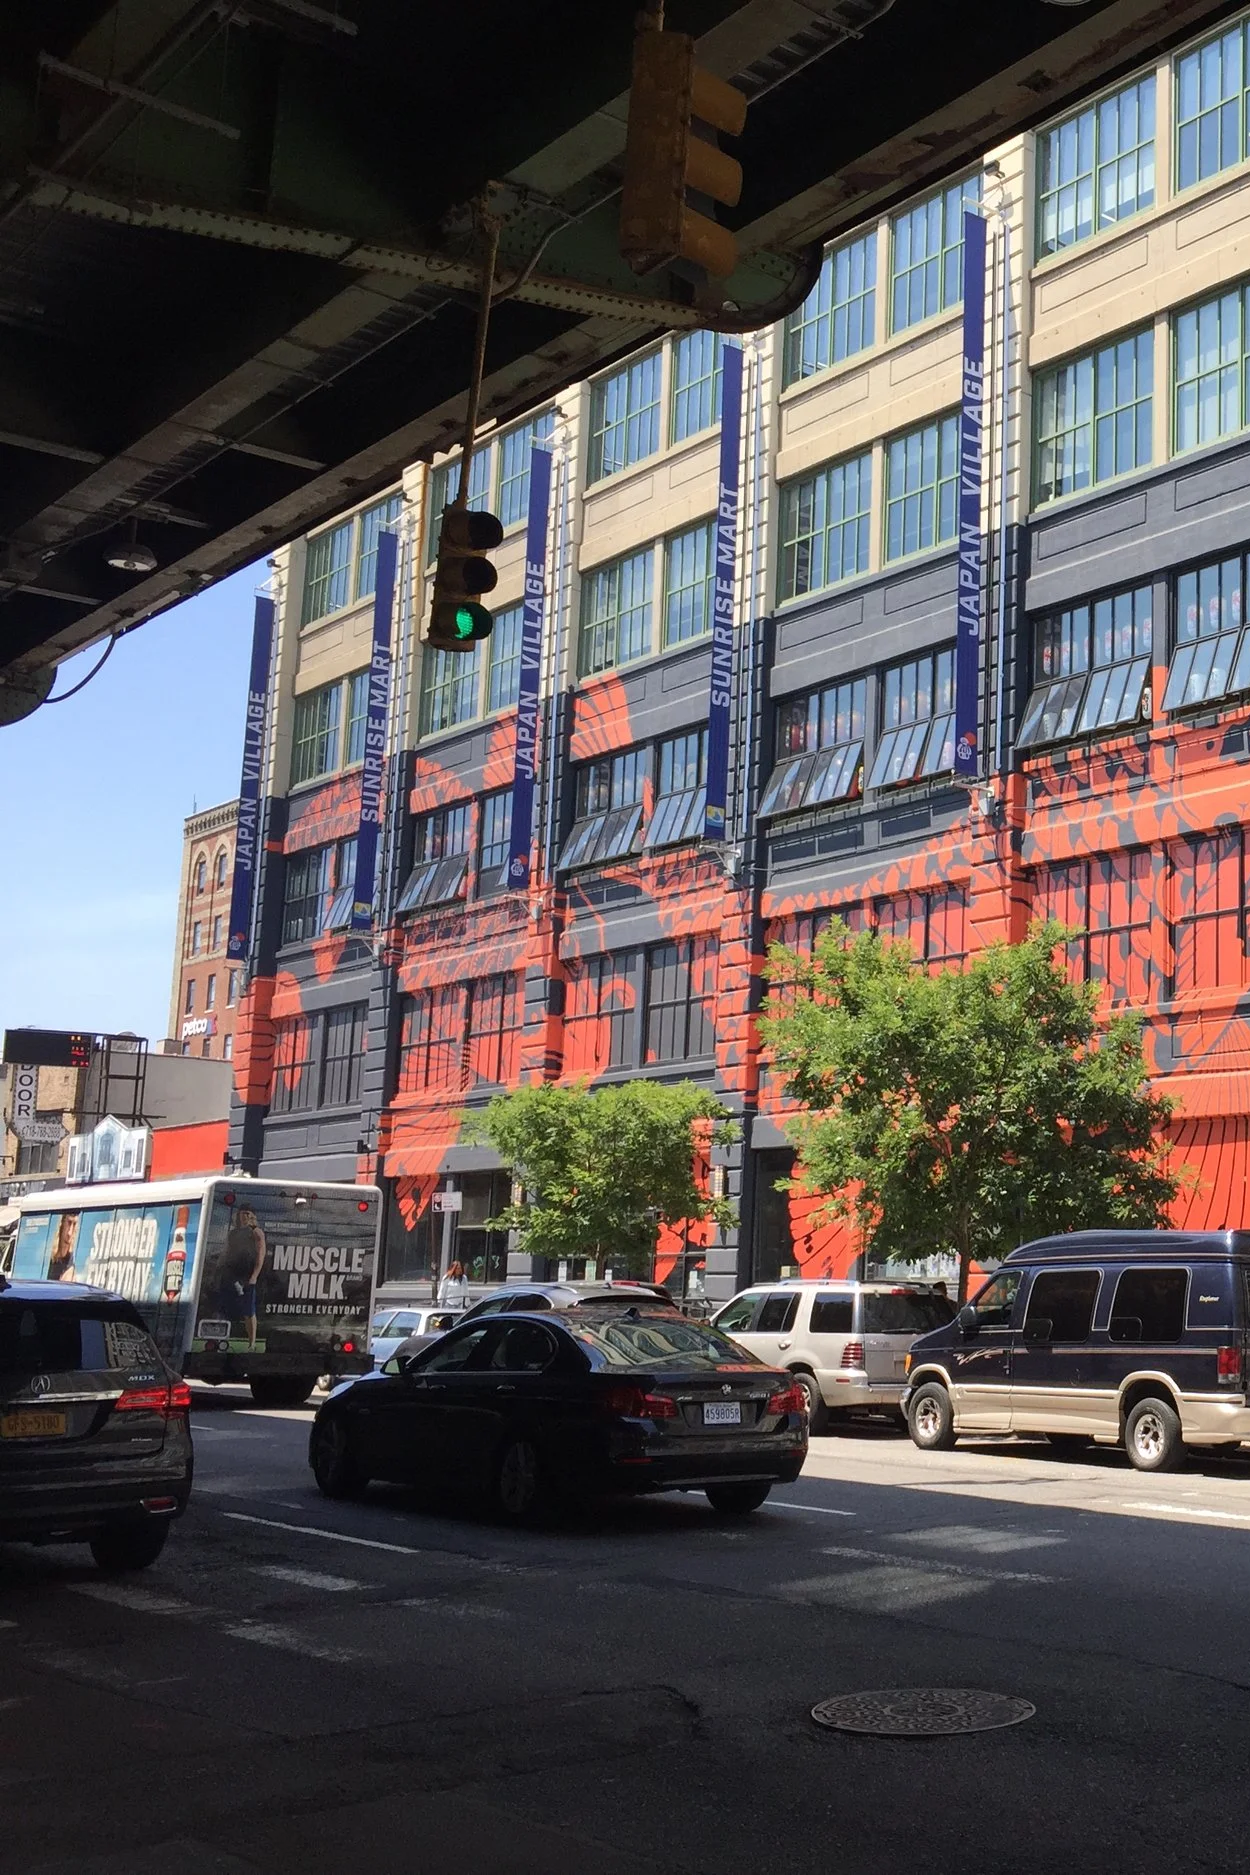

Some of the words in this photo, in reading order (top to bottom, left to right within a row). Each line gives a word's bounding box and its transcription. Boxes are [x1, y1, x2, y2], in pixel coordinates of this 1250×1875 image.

[962, 356, 983, 497] VILLAGE
[717, 482, 739, 567] MART
[521, 560, 545, 670] VILLAGE
[959, 522, 981, 636] JAPAN
[369, 640, 391, 709] MART
[711, 576, 735, 708] SUNRISE
[243, 690, 266, 781] VILLAGE
[361, 716, 385, 823] SUNRISE
[515, 691, 538, 780] JAPAN
[236, 799, 257, 871] JAPAN
[182, 1018, 208, 1040] petco
[273, 1245, 365, 1273] MUSCLE
[287, 1273, 345, 1300] MILK
[265, 1303, 313, 1314] STRONGER
[316, 1305, 361, 1315] EVERYDAY
[128, 1374, 155, 1382] MDX
[705, 1407, 740, 1421] 459805R
